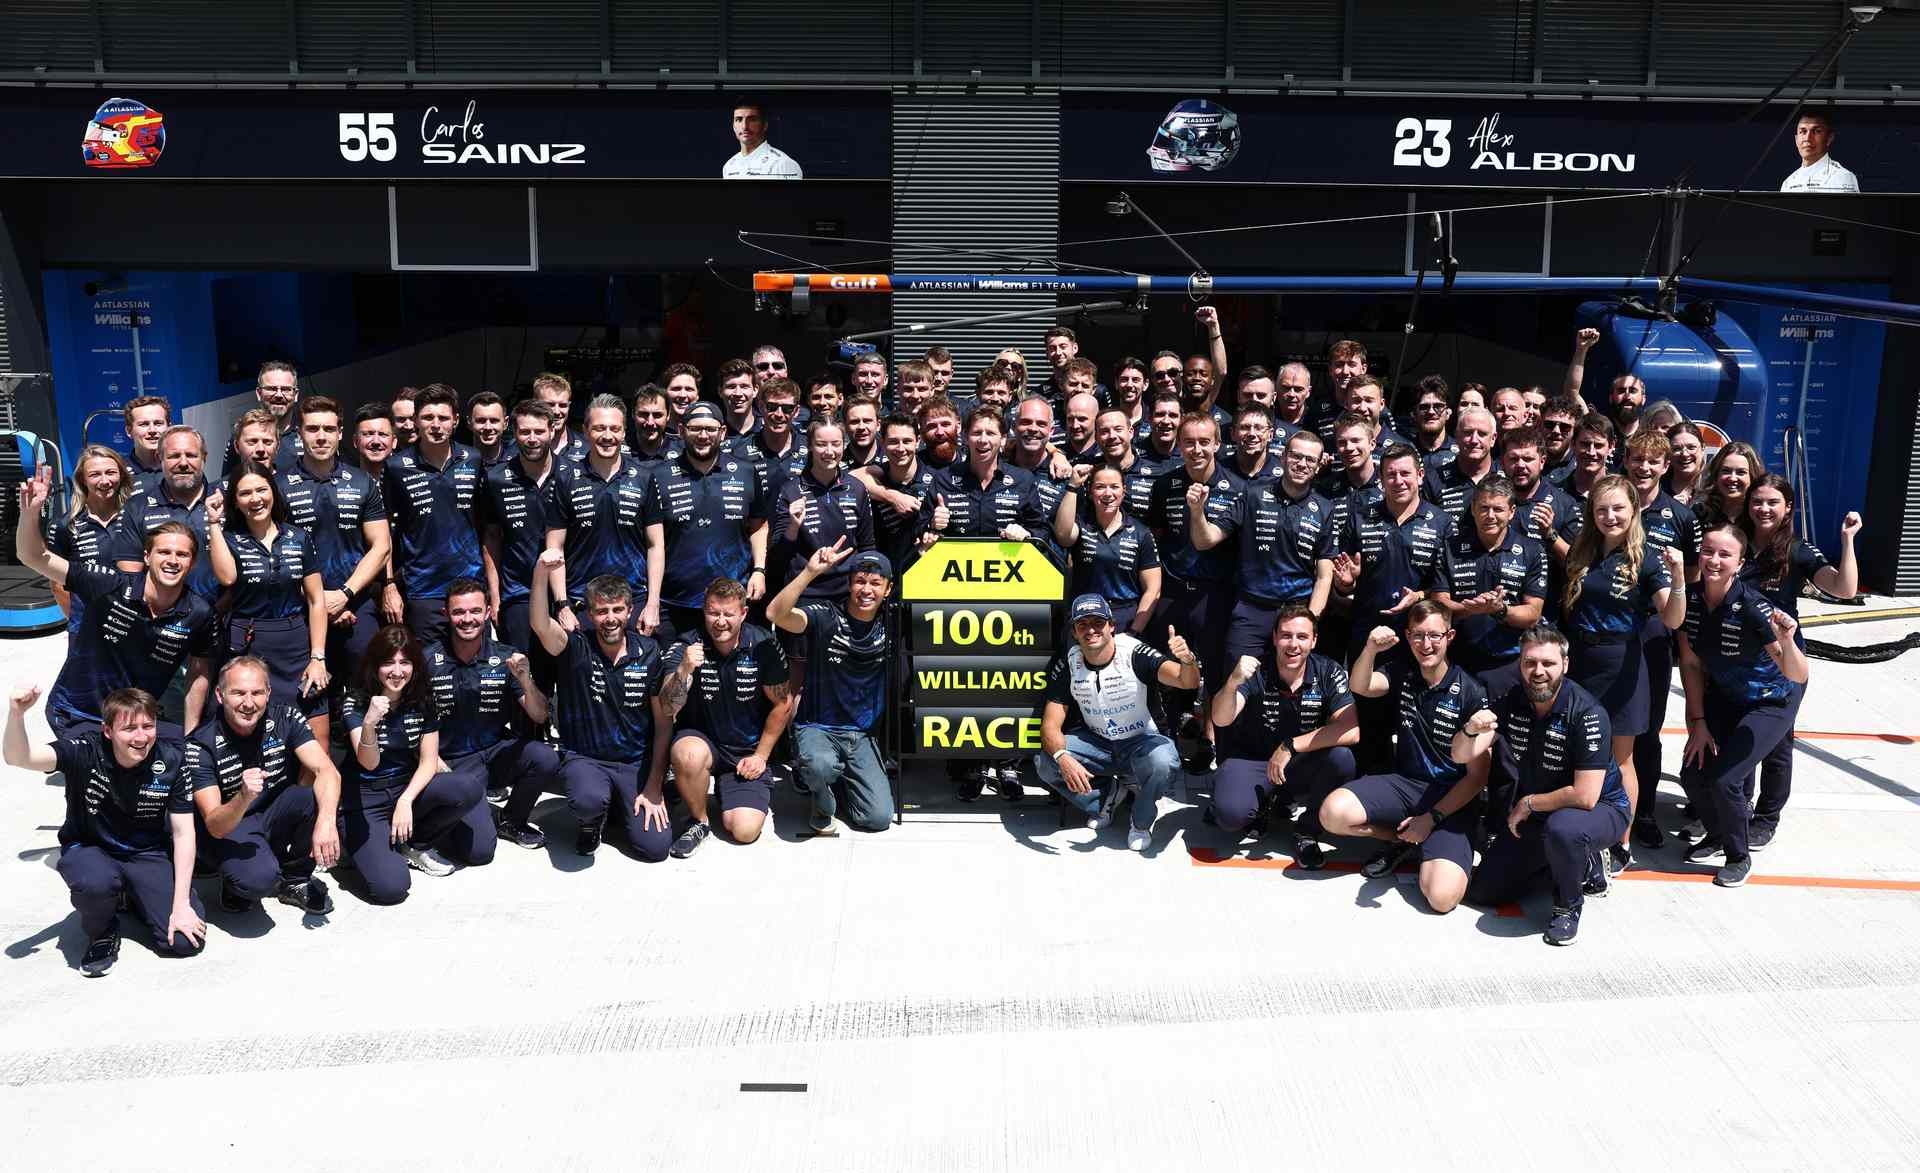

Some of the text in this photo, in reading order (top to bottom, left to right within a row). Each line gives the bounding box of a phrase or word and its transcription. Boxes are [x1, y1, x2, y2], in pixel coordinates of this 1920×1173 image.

[421, 99, 484, 143] Carlos
[339, 112, 398, 162] 55
[1393, 117, 1452, 168] 23
[1468, 112, 1514, 154] Alex
[422, 143, 586, 164] SAINZ
[1470, 151, 1635, 172] ALBON
[830, 276, 878, 290] Gulf
[919, 280, 970, 289] ATLASSIAN
[978, 279, 1029, 290] Williams
[1790, 314, 1837, 322] ATLASSIAN
[1780, 327, 1835, 338] Willims
[941, 559, 1025, 583] ALEX
[924, 609, 1034, 646] 100th
[918, 671, 1048, 690] WILLIAMS
[1092, 703, 1136, 716] BARCLAYS
[922, 716, 1042, 749] RACE
